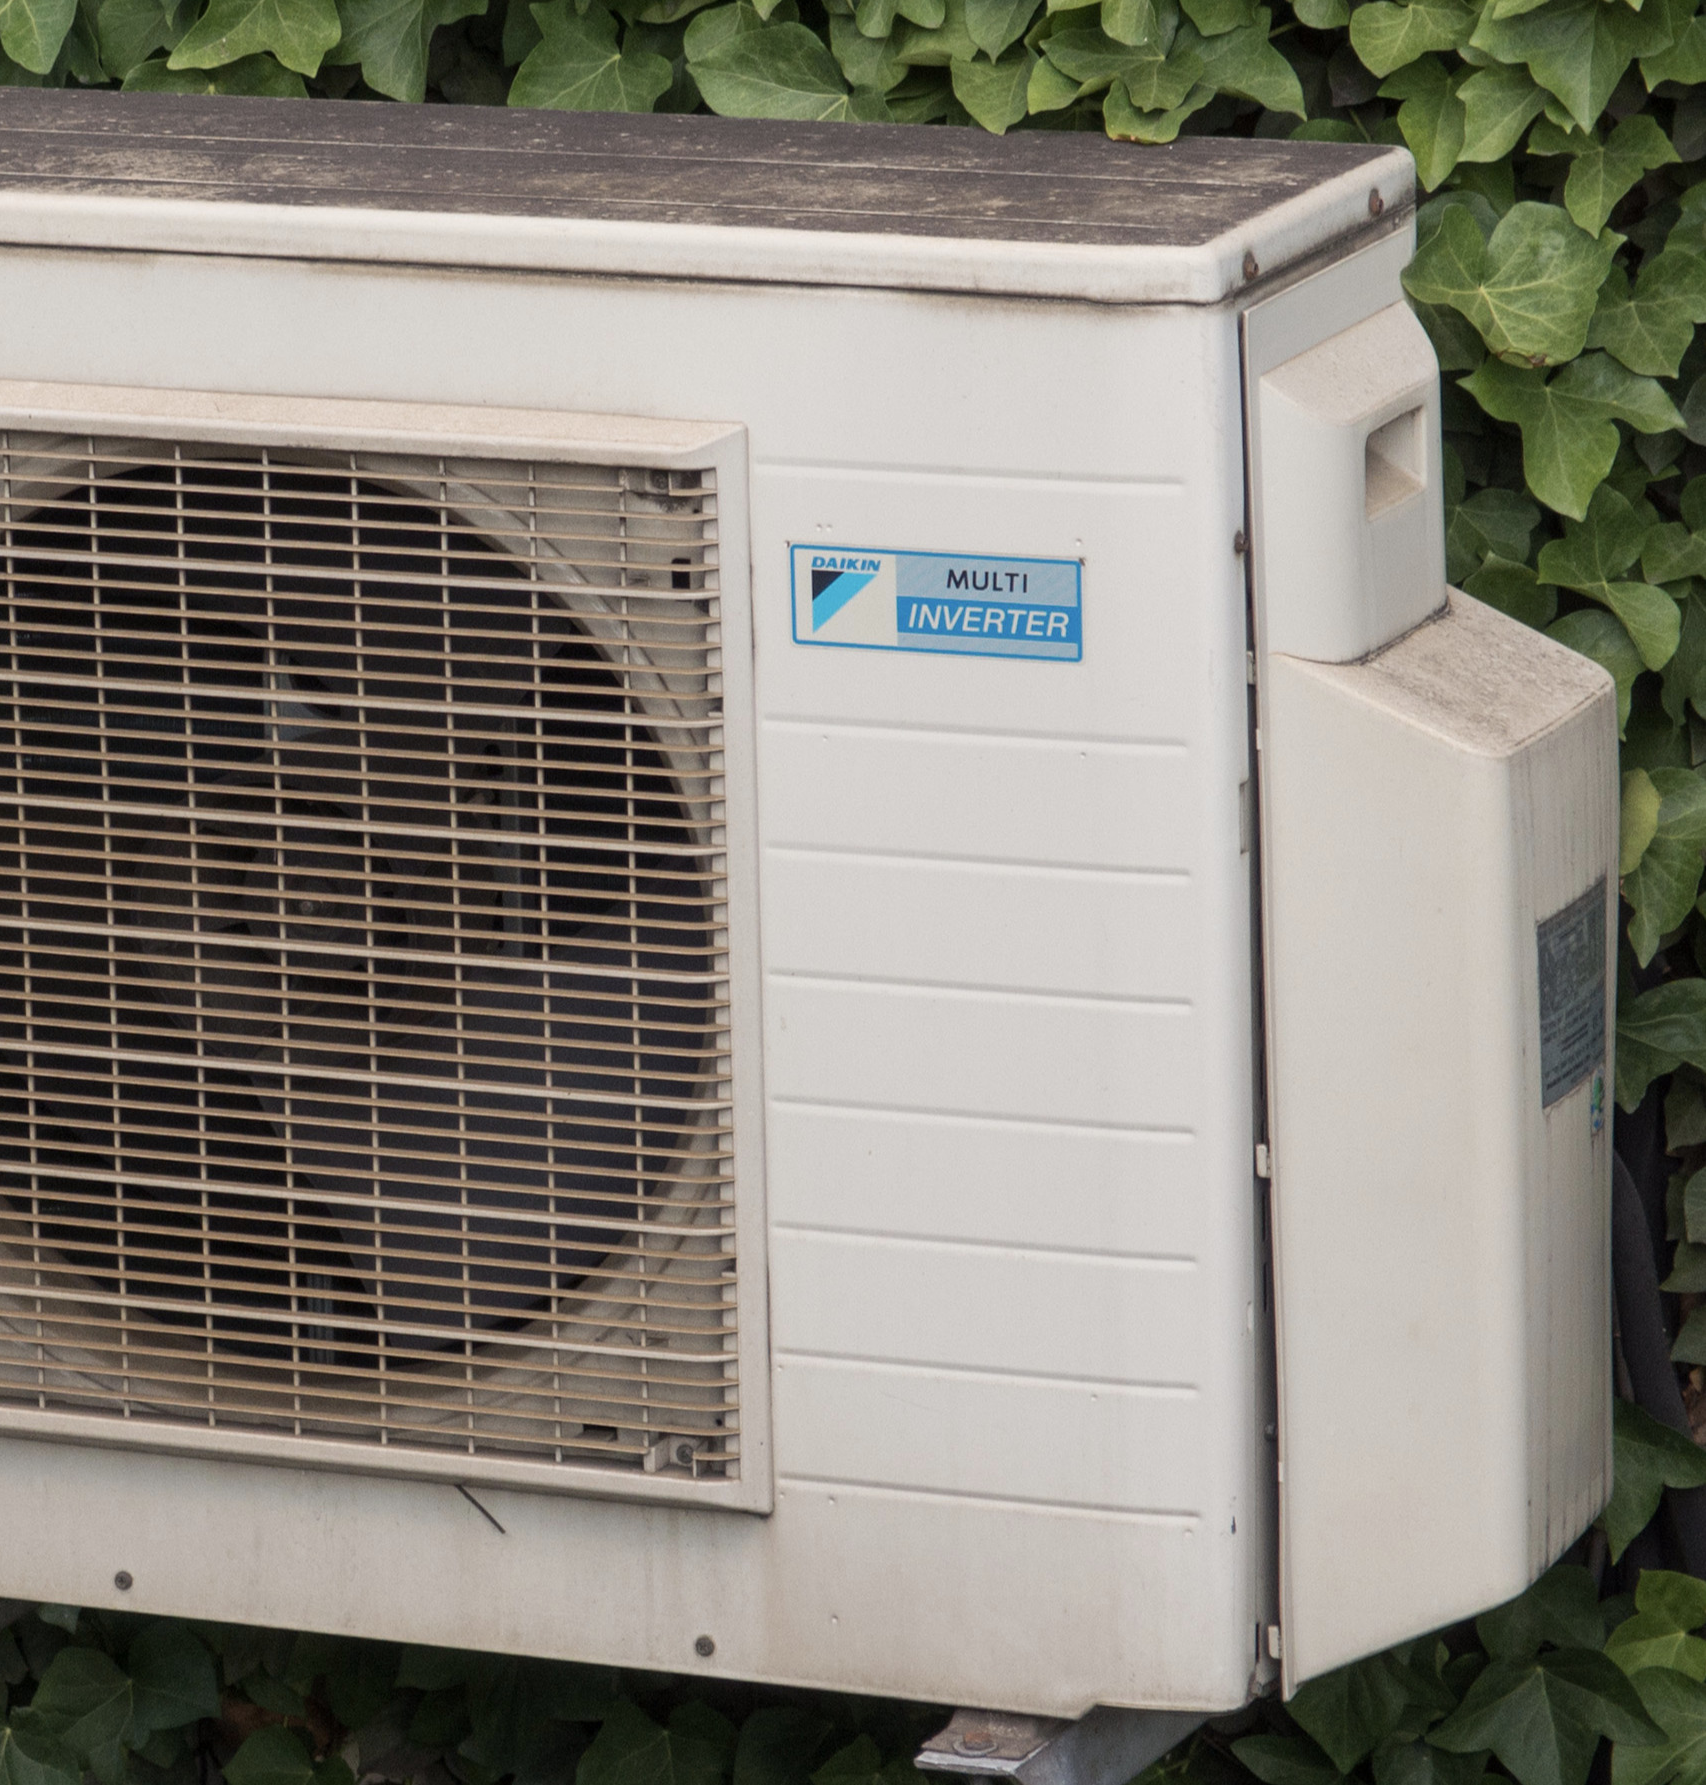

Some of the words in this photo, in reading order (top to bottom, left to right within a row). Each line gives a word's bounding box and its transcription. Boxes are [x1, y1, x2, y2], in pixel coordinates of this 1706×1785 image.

[811, 556, 881, 571] DAIKIN
[946, 569, 1028, 593] MULTI
[908, 603, 1069, 637] INVERTER
